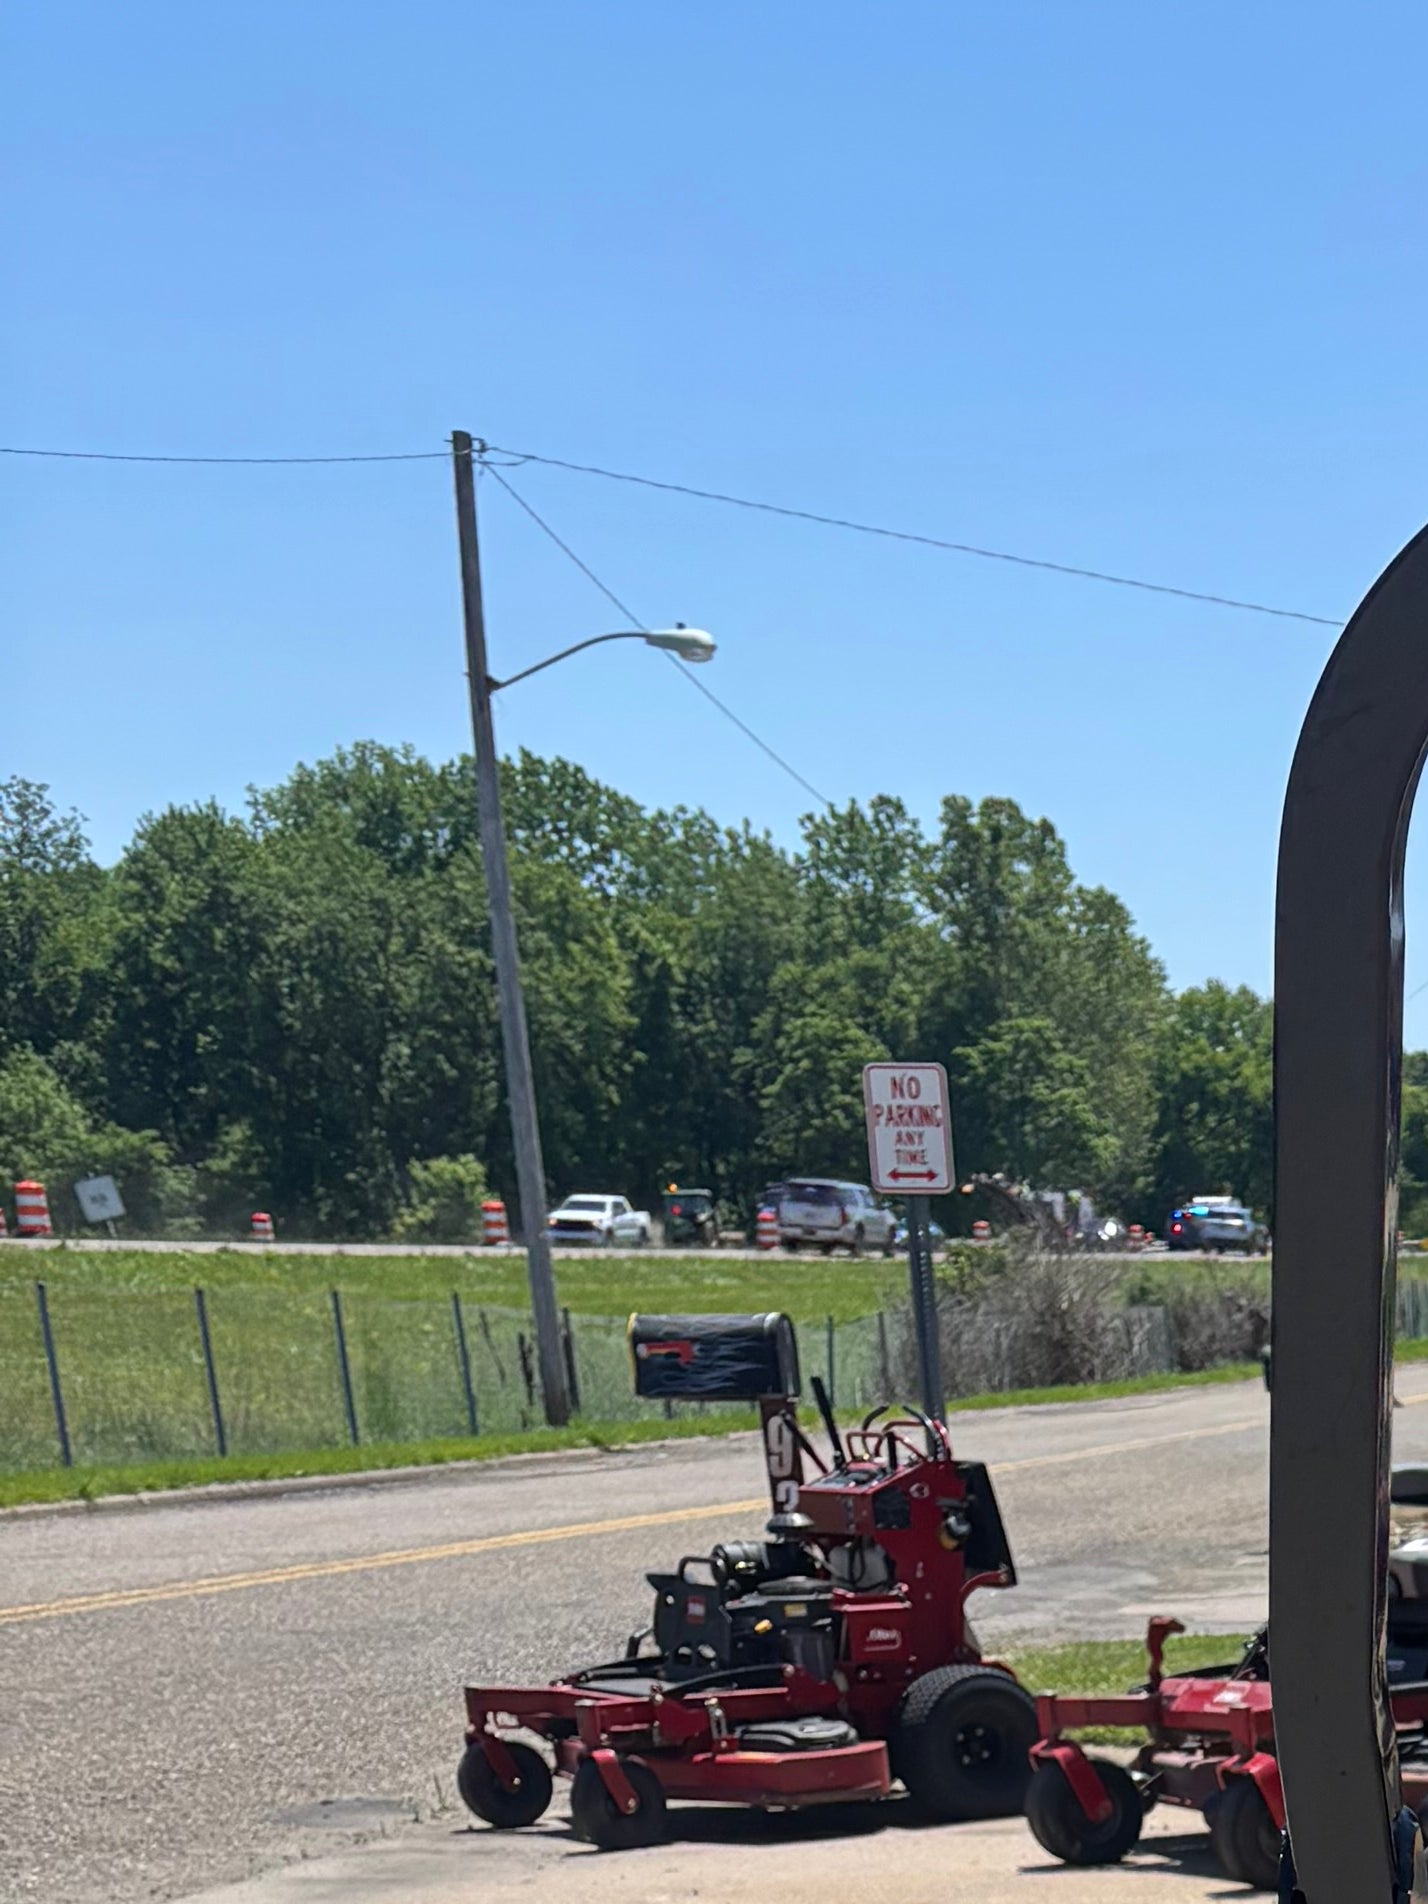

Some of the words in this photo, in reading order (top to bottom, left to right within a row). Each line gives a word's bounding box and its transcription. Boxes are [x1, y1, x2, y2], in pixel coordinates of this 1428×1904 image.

[890, 1075, 922, 1100] NO
[872, 1103, 942, 1128] PARKING
[894, 1130, 925, 1146] ANY
[894, 1148, 928, 1165] TIME
